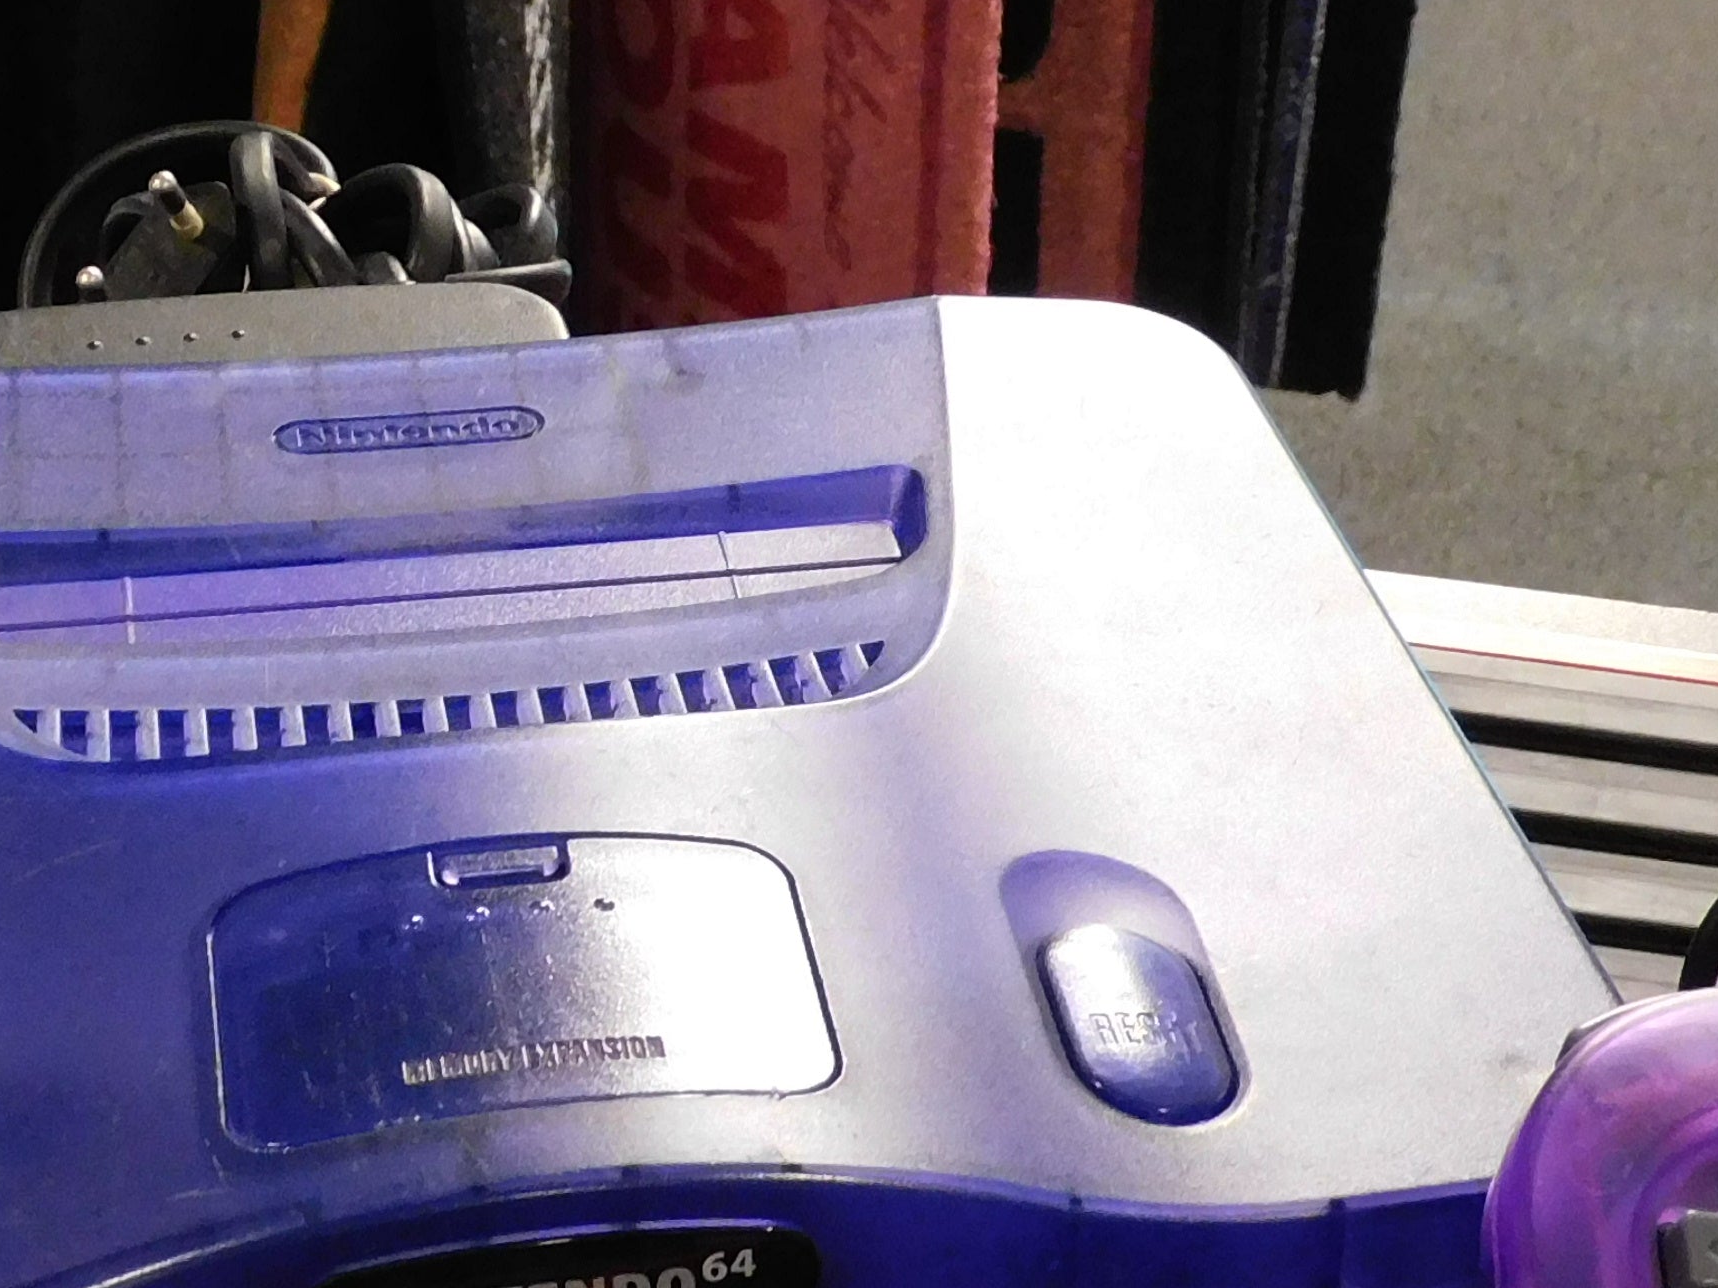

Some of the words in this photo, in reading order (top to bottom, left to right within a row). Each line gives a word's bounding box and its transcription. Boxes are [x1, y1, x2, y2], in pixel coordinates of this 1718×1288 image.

[295, 415, 521, 448] Nintendo
[519, 1035, 667, 1069] EXPANSION
[701, 1248, 757, 1283] 64
